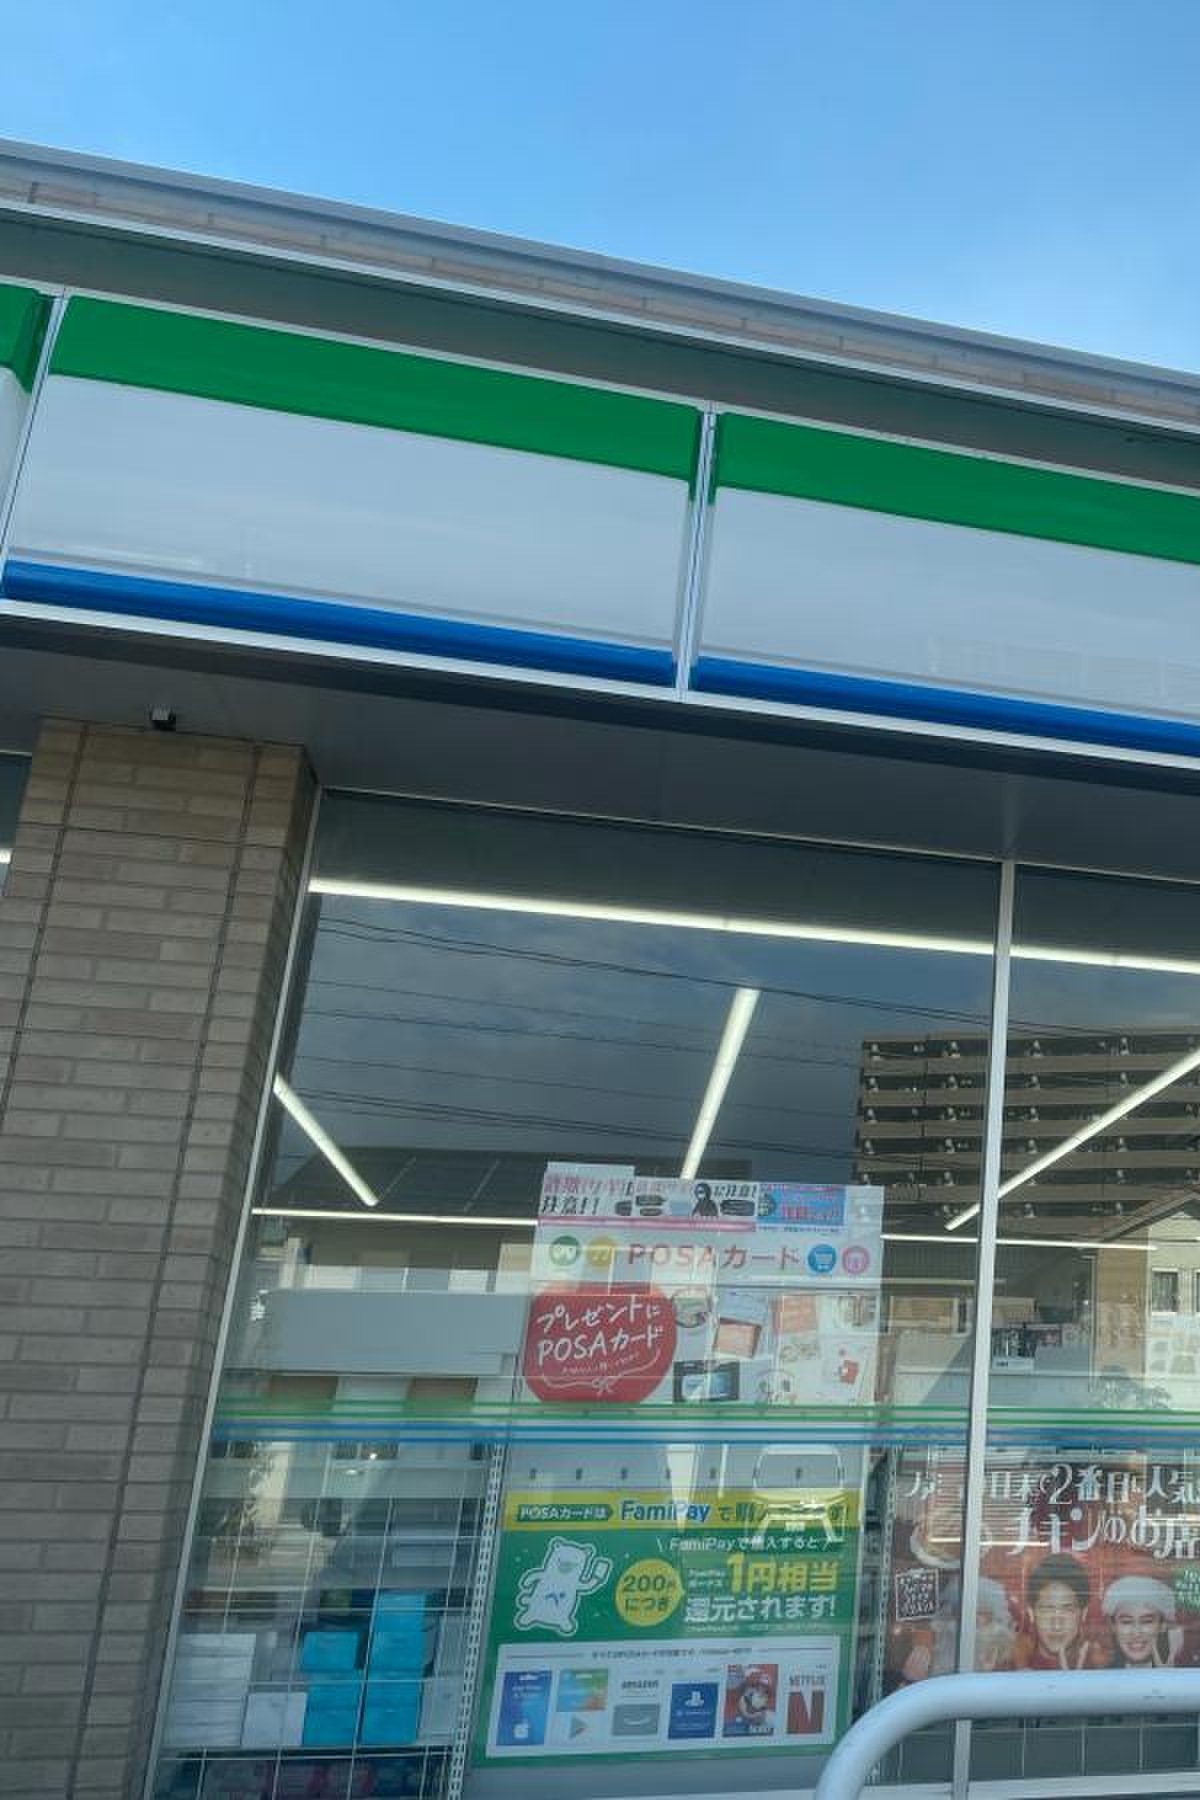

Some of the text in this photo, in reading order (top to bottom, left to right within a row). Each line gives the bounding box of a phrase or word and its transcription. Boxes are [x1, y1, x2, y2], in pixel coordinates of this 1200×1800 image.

[628, 1243, 800, 1270] POSAカード
[537, 1295, 661, 1333] プレゼントに
[537, 1325, 664, 1366] POSAカード
